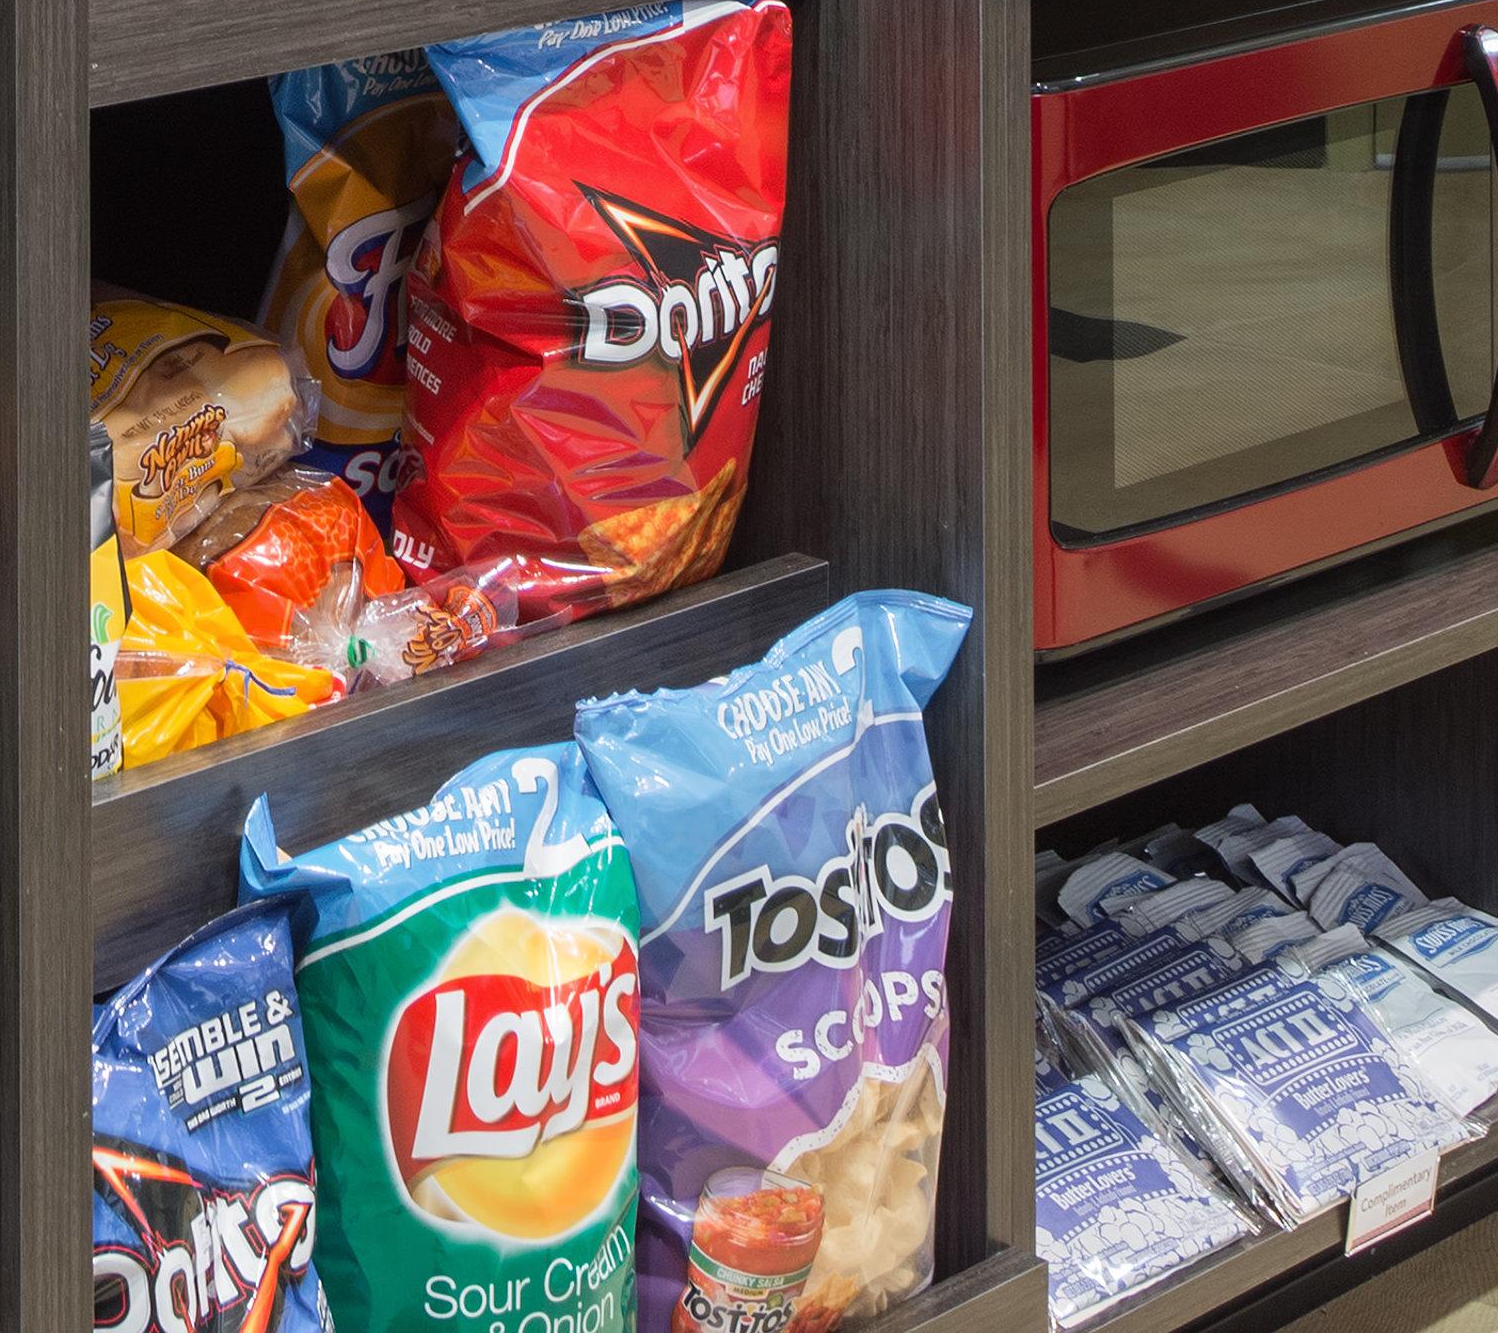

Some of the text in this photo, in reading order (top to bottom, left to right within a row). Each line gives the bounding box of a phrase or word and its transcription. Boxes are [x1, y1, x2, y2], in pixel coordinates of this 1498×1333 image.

[140, 403, 227, 488] Nature's
[716, 657, 842, 744] CHOOSE ANY
[410, 959, 638, 1160] Lay's
[1240, 1014, 1300, 1070] ACT
[593, 1092, 621, 1109] BRAND
[1359, 1165, 1433, 1213] Complimentary
[1384, 1198, 1408, 1220] Item
[422, 1222, 633, 1320] Sour Cream
